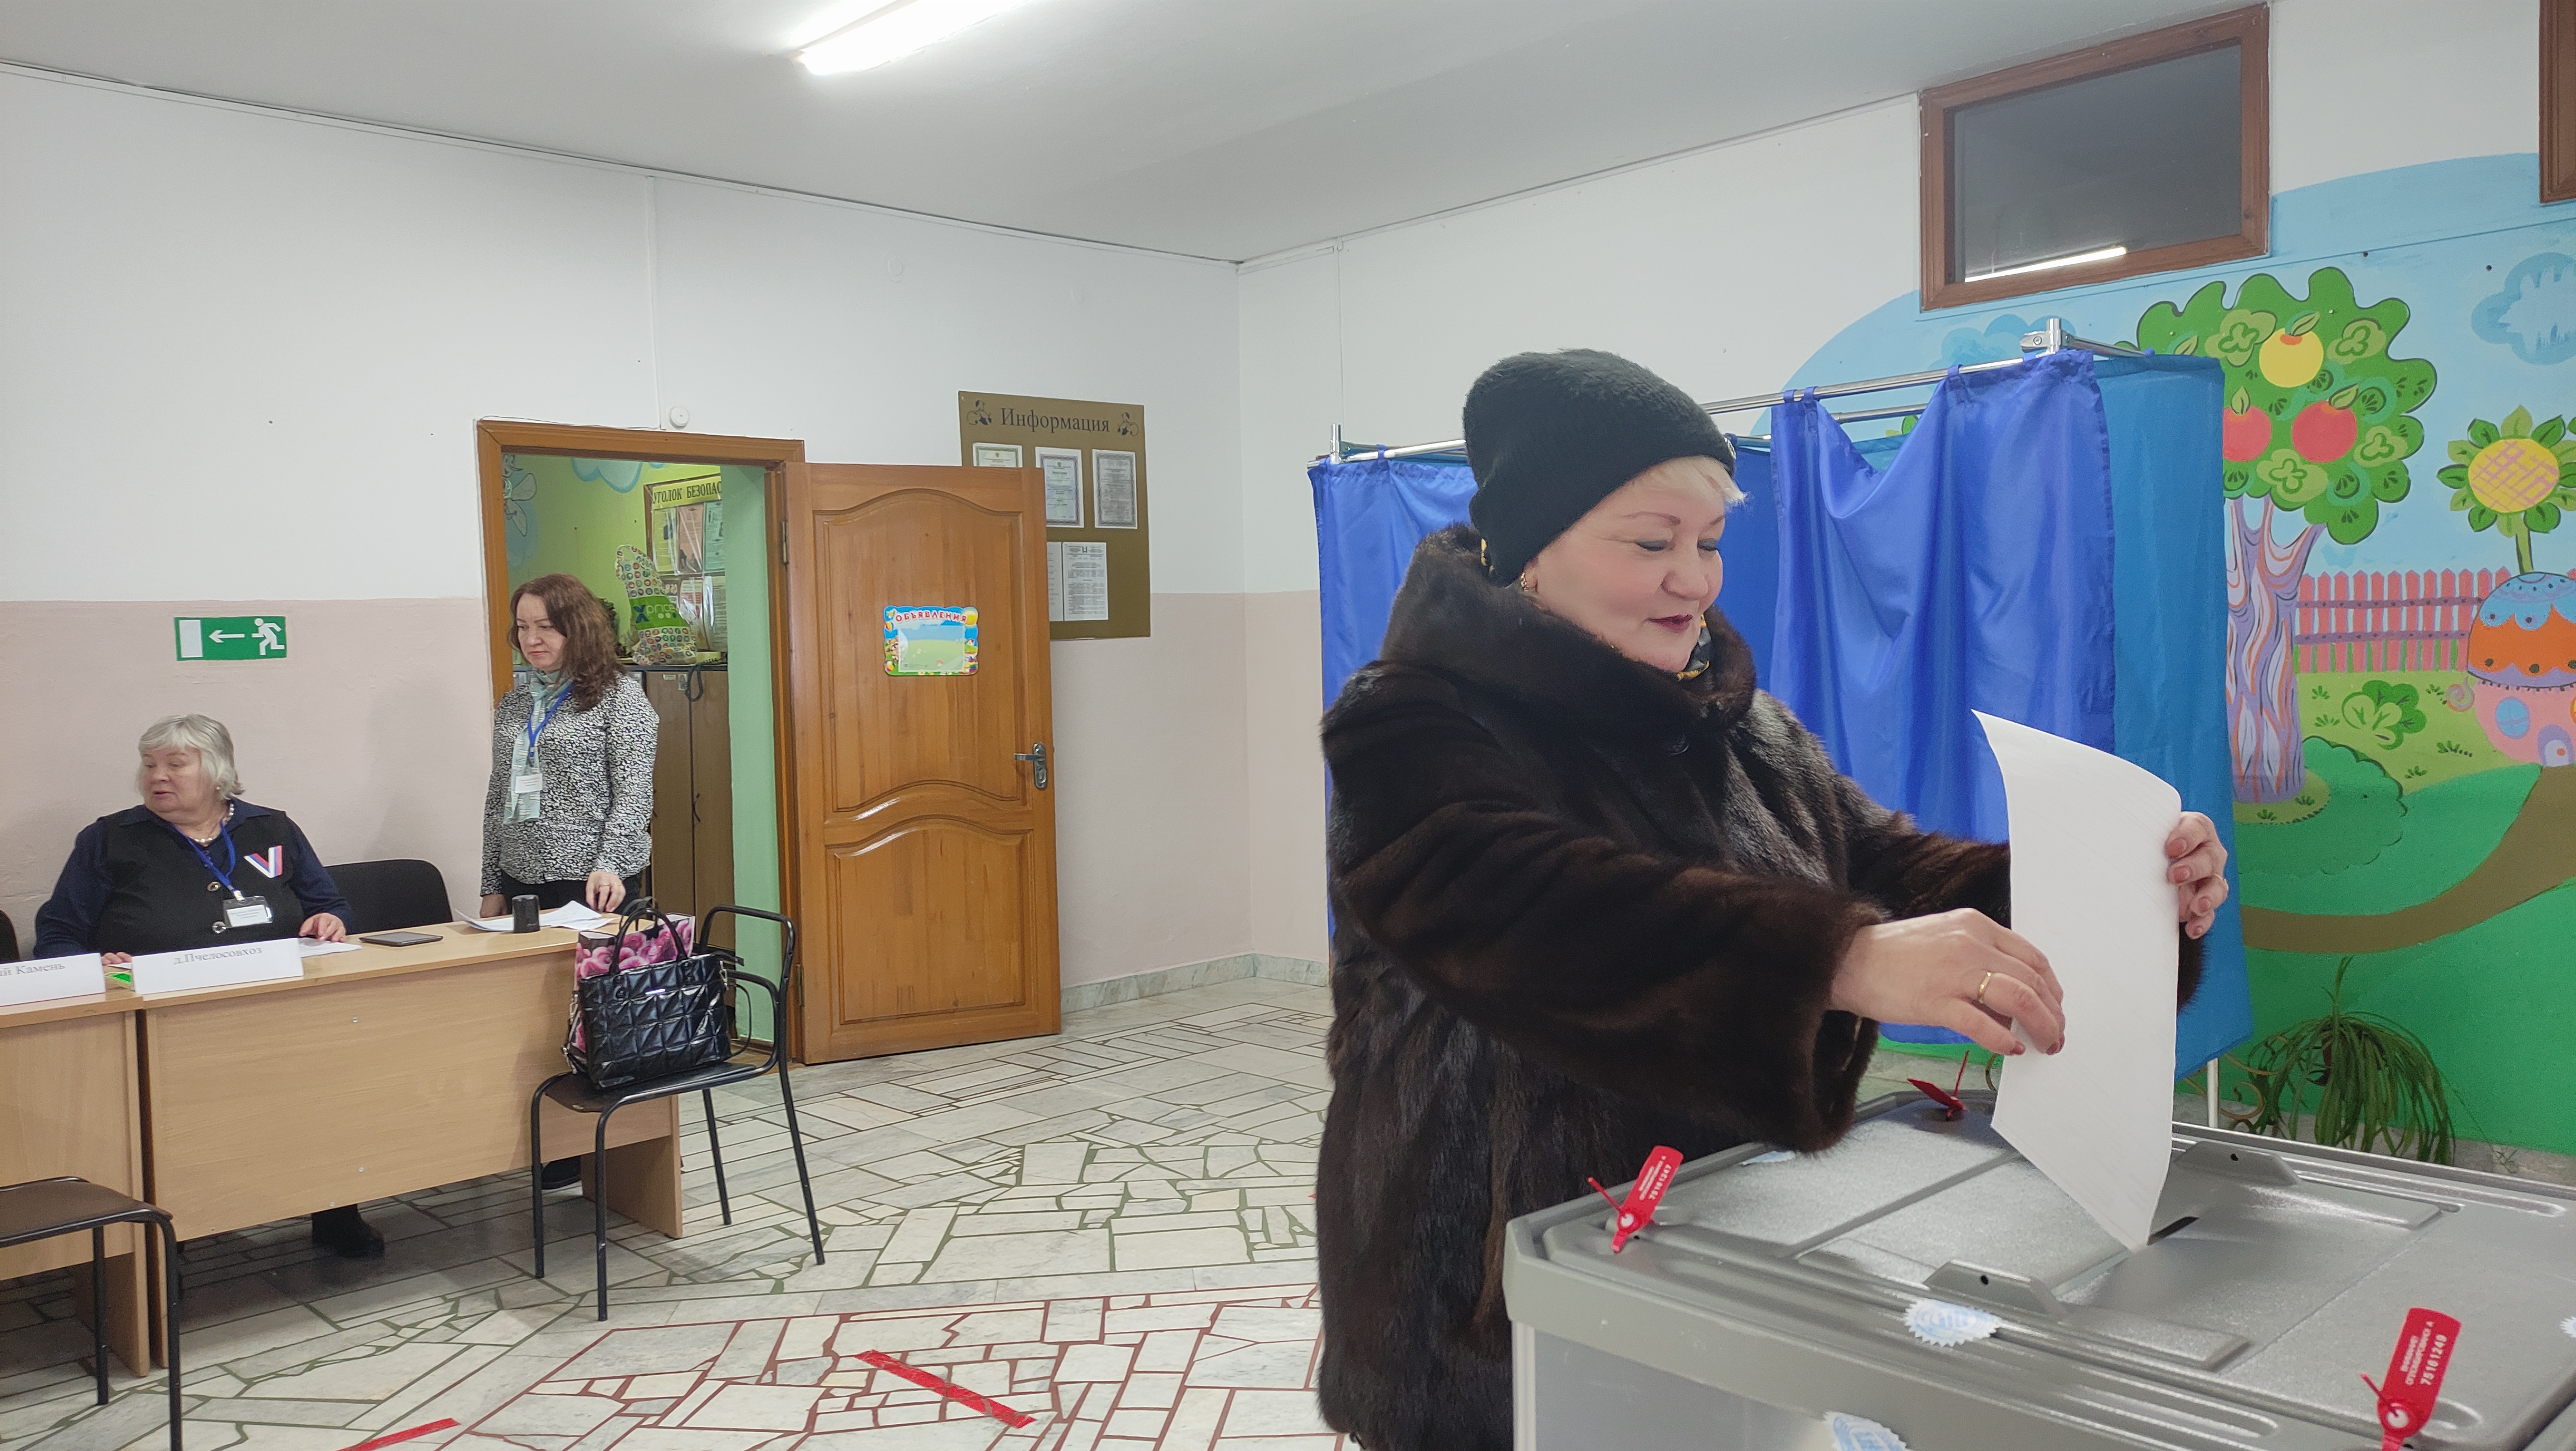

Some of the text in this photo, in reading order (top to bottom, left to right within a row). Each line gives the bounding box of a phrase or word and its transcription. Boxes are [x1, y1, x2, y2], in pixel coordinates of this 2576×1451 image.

[1001, 407, 1109, 434] Информация
[653, 488, 682, 504] УГОЛОК
[16, 963, 65, 975] Камень
